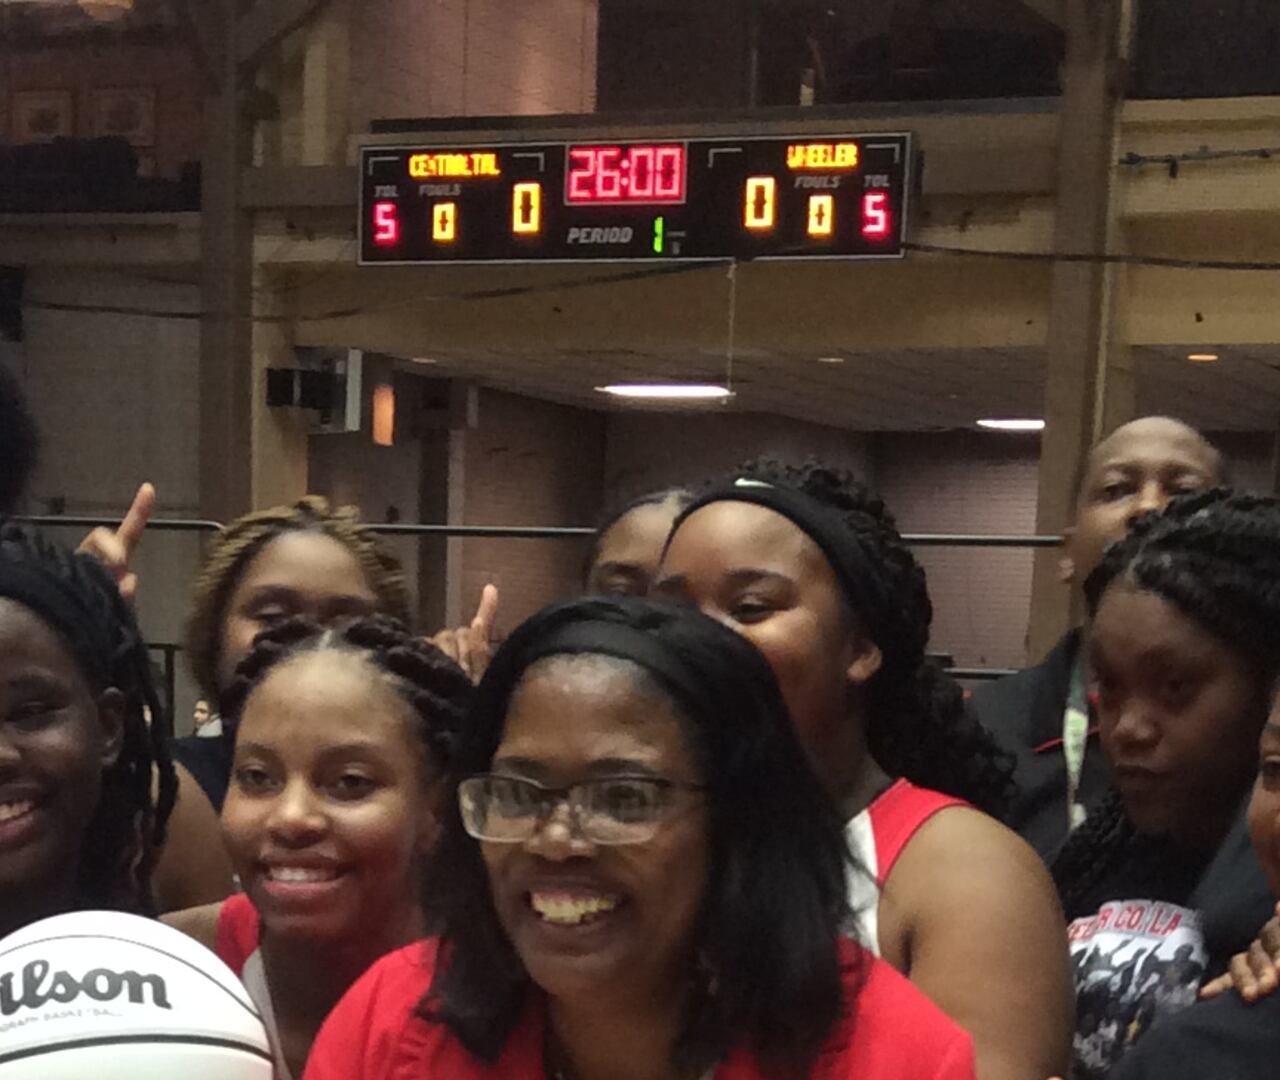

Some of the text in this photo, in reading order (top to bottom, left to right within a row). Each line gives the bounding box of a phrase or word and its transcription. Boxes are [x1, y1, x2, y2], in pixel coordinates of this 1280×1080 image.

[569, 147, 683, 198] 26:00
[794, 176, 841, 189] FOULS
[864, 175, 891, 188] TOL
[374, 203, 397, 240] 5
[433, 203, 455, 240] 0
[513, 183, 540, 233] 0
[744, 177, 775, 228] 0
[807, 195, 832, 234] 0
[862, 193, 887, 233] 5
[566, 226, 634, 243] PERIOD
[653, 216, 664, 253] 1
